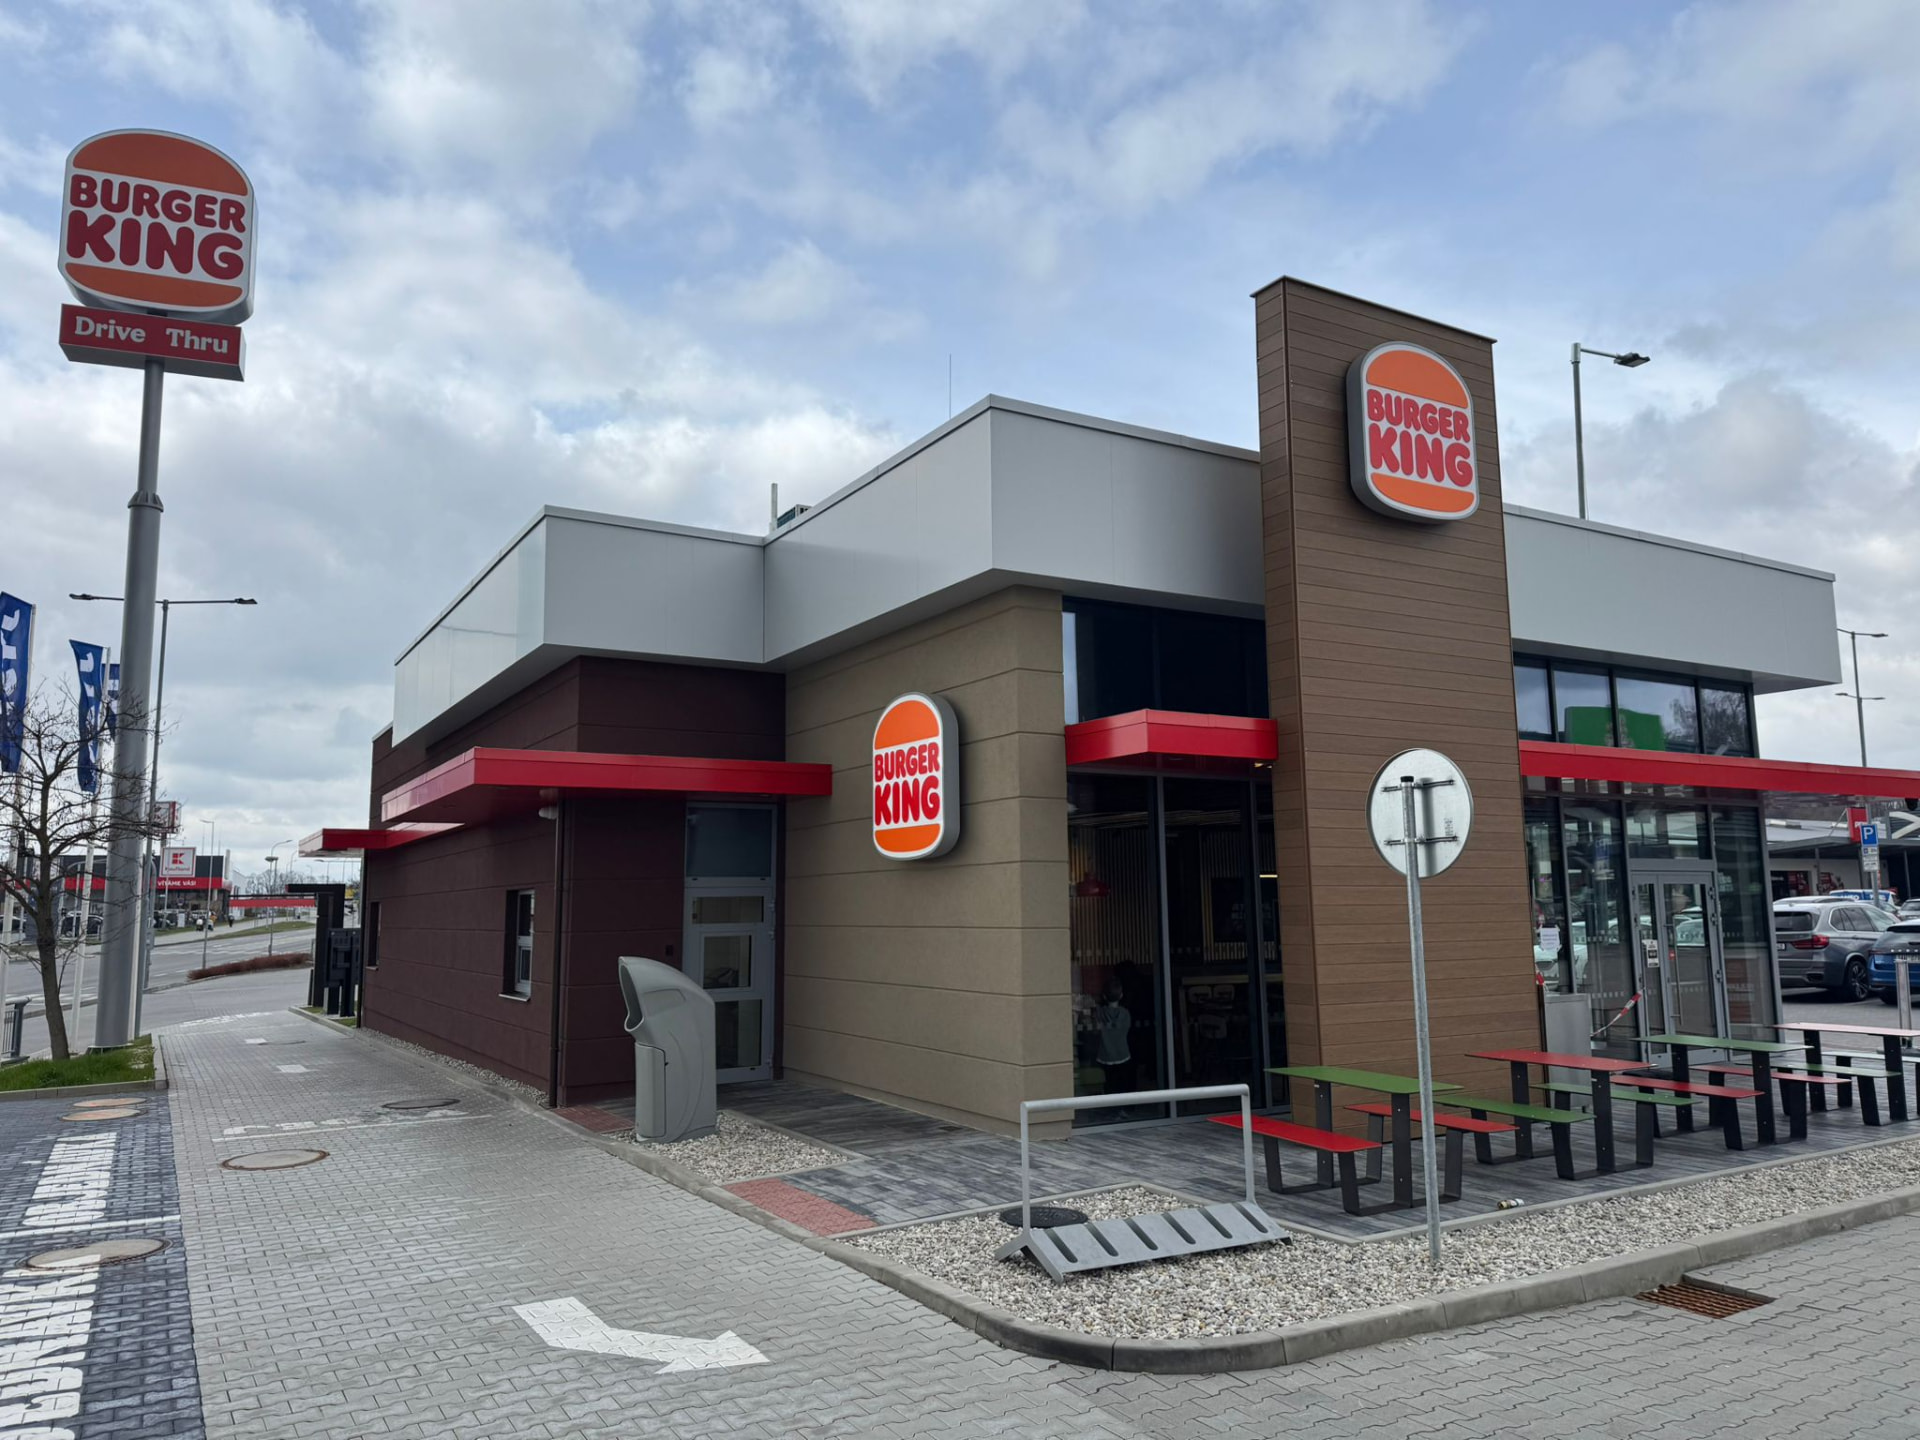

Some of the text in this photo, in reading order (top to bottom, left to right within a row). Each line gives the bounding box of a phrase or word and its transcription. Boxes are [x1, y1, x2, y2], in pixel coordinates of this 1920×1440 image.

[69, 173, 246, 233] BURGER
[66, 209, 244, 280] KING
[75, 315, 228, 353] Drive Thru
[1366, 388, 1471, 443] BURGER
[1368, 422, 1474, 487] KING
[874, 741, 941, 783] BURGER
[874, 774, 941, 827] KING
[1863, 826, 1874, 840] P
